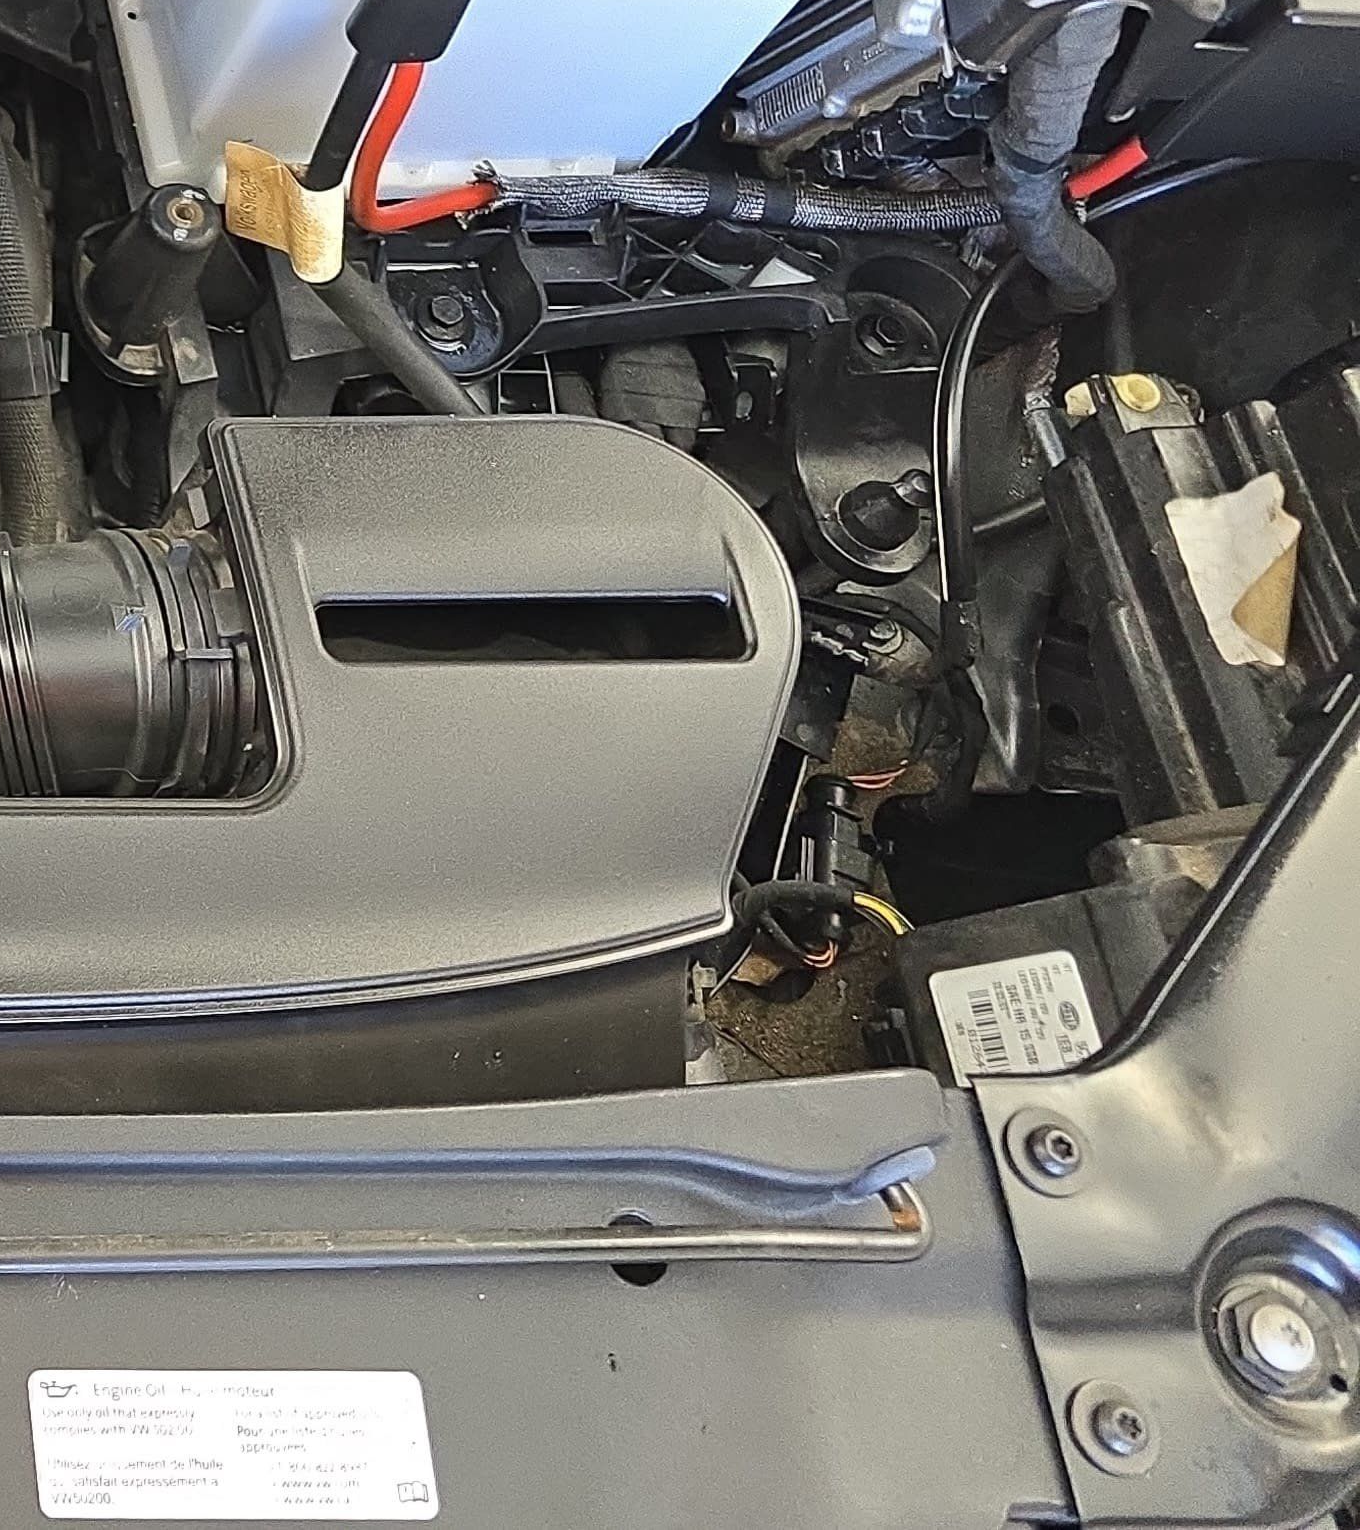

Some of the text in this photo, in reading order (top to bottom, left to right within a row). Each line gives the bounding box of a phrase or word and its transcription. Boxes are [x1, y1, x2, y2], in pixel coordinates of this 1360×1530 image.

[238, 168, 263, 233] Volkswagen
[93, 1383, 142, 1401] Engine
[145, 1383, 165, 1397] Oil
[237, 1425, 263, 1437] Pour
